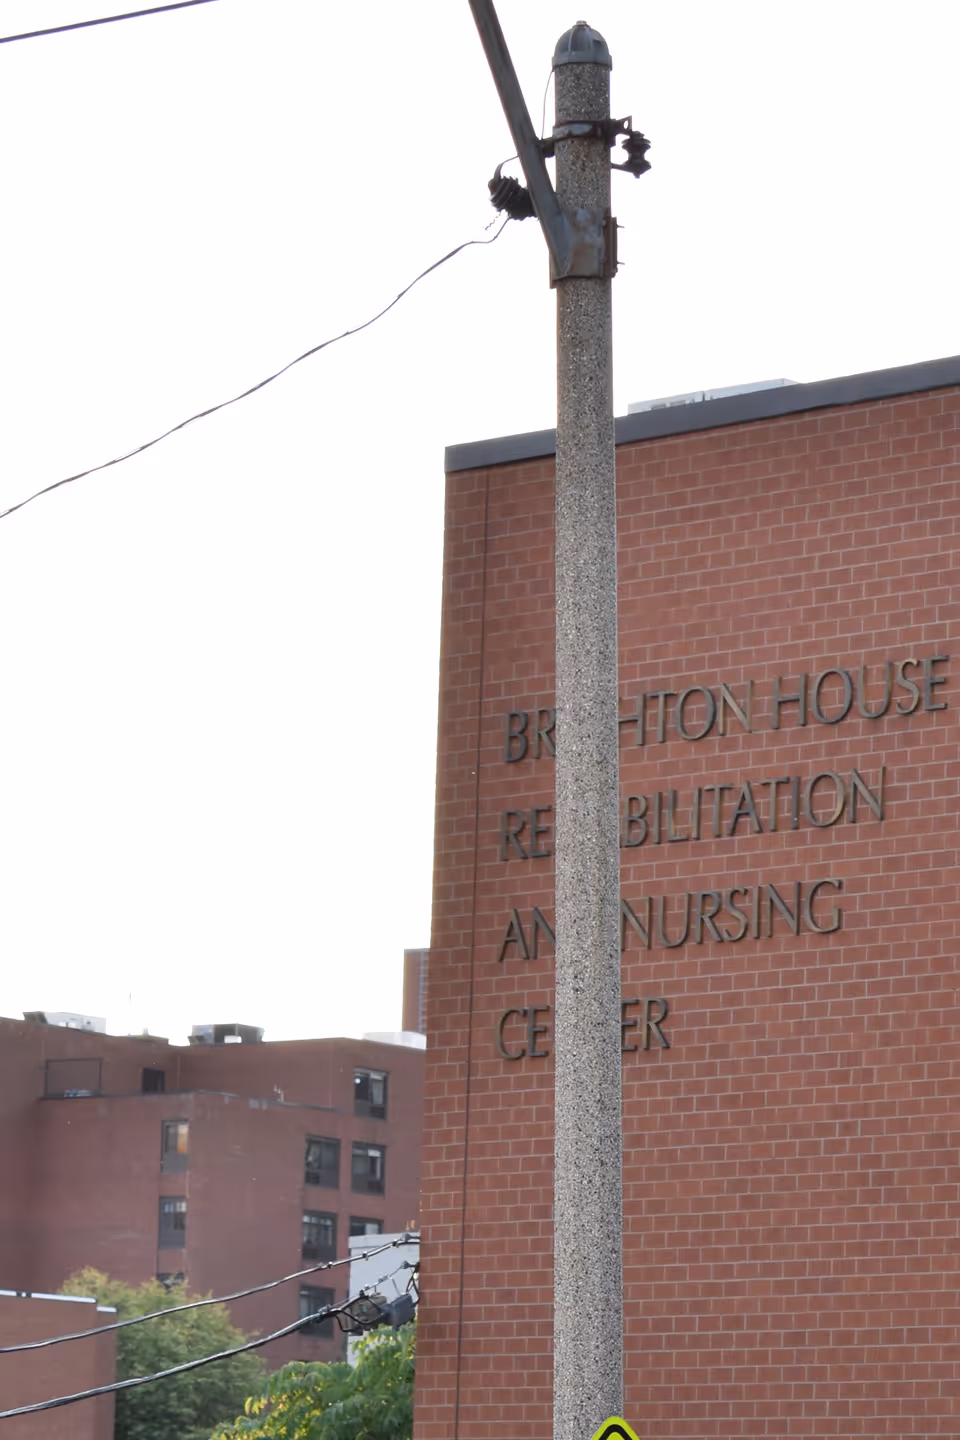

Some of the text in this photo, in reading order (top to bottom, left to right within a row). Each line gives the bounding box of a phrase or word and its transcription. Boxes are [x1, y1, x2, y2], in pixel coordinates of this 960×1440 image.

[504, 654, 949, 763] BRHTON HOUSE
[500, 766, 886, 862] REBILITATION
[499, 906, 556, 962] AN
[498, 997, 670, 1061] CEER
